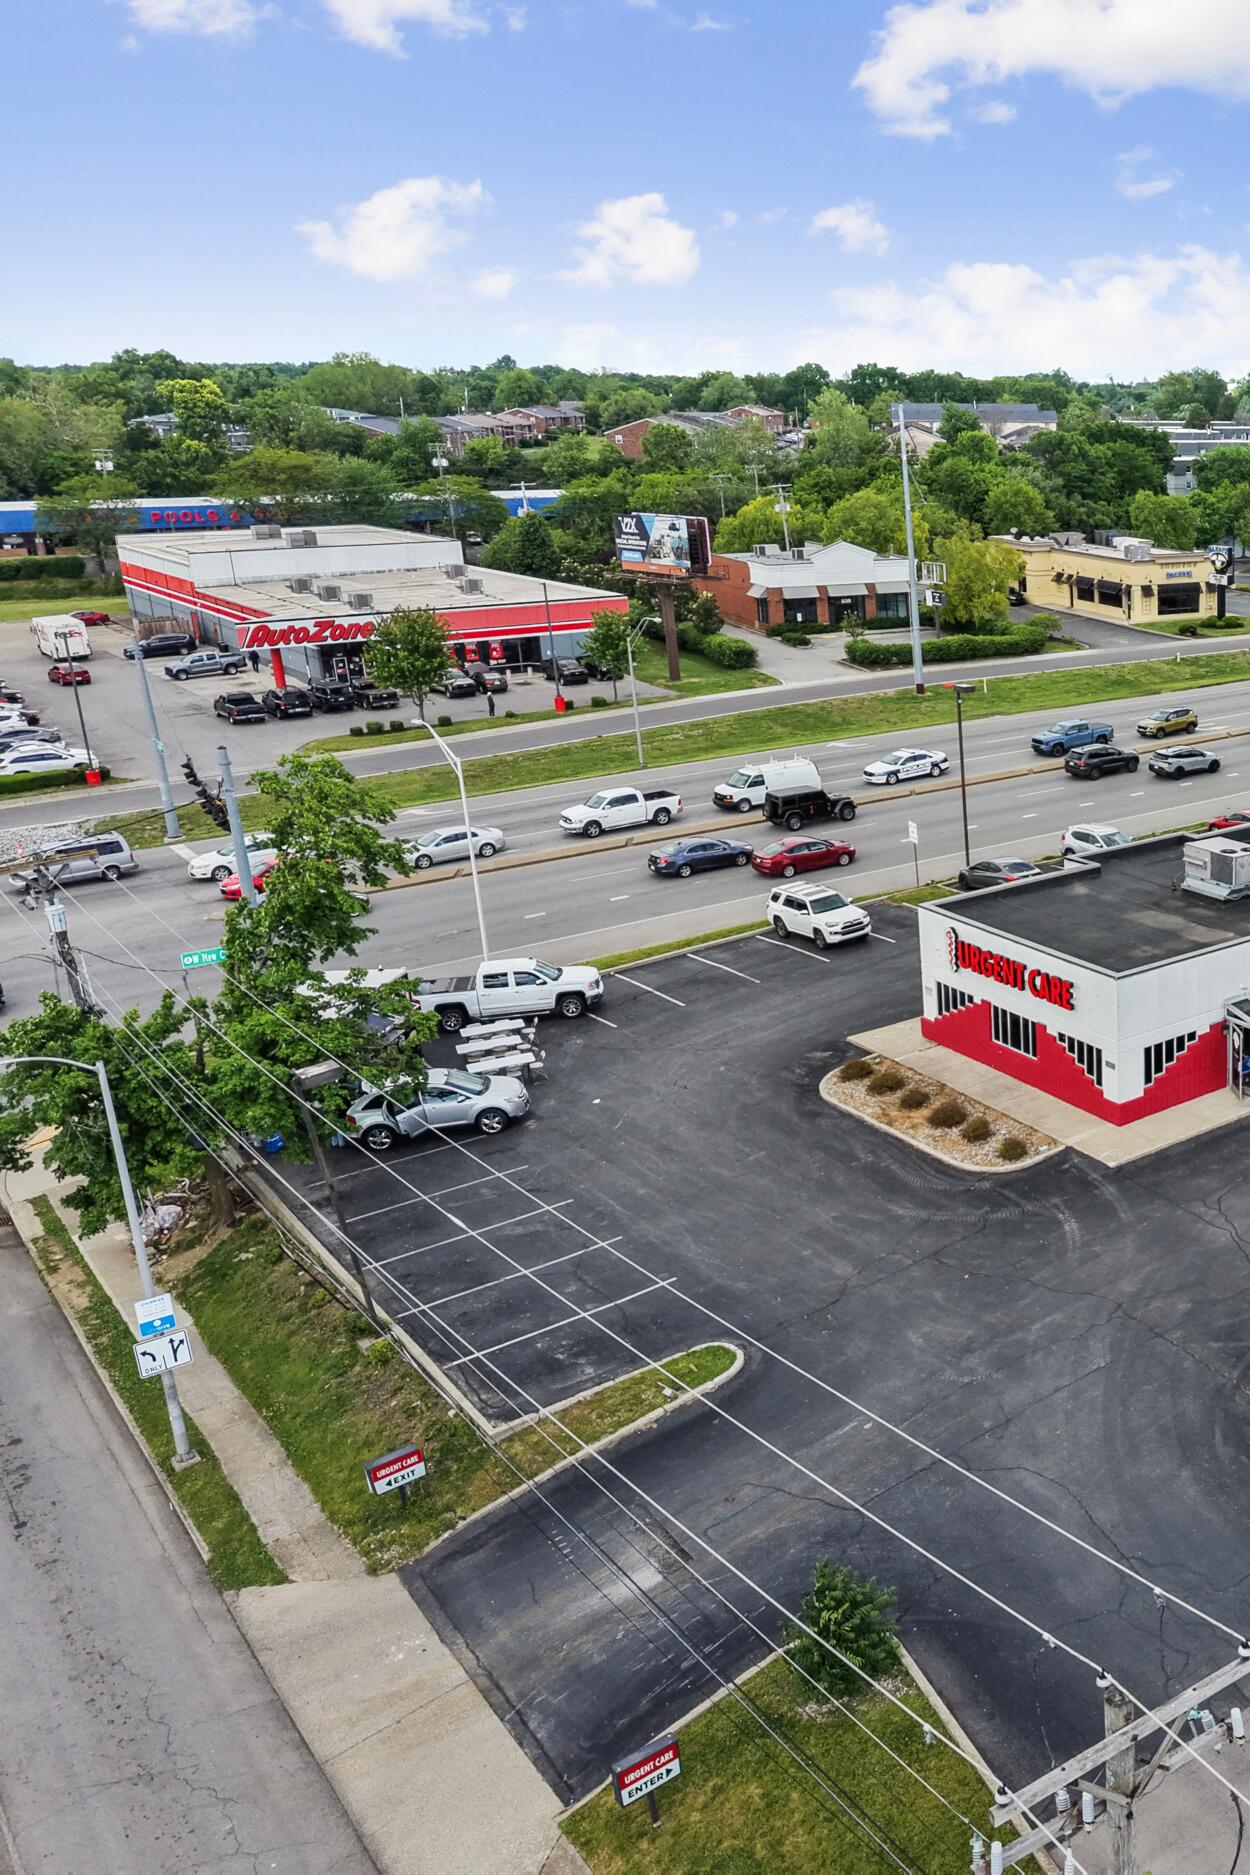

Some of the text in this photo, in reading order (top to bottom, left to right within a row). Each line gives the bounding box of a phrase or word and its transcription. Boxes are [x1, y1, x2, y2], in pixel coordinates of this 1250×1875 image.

[150, 510, 220, 524] POOLS
[245, 619, 377, 649] AutoZone
[202, 952, 217, 963] New
[957, 939, 1075, 1011] URGENT CARE
[144, 1363, 162, 1374] ONLY
[376, 1454, 419, 1478] URGENT CARE
[393, 1469, 416, 1484] EXIT
[624, 1750, 674, 1785] URGENT CARE
[627, 1772, 664, 1799] ENTER
